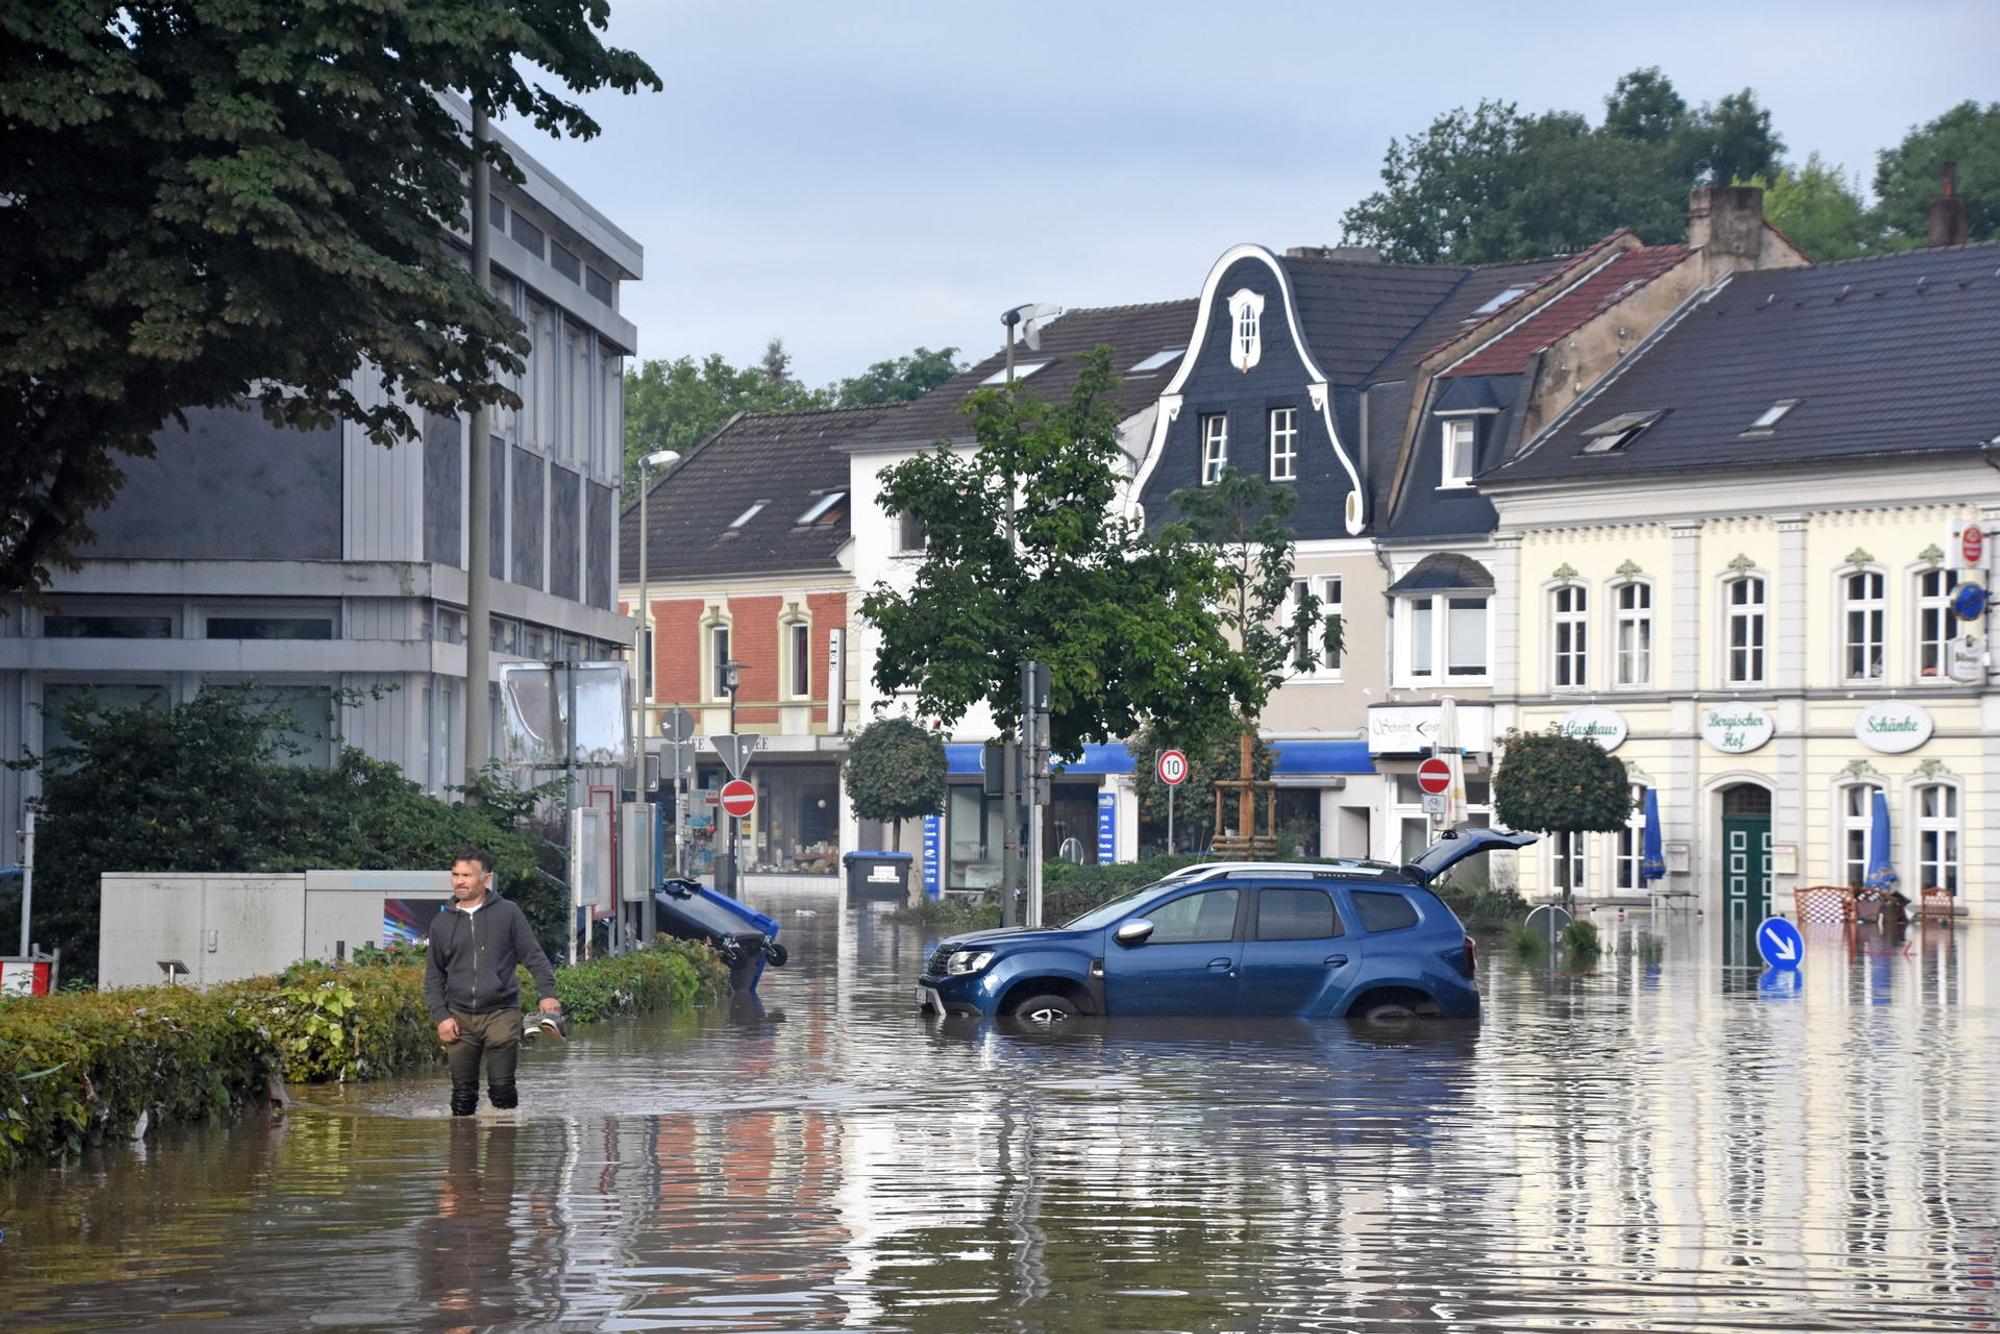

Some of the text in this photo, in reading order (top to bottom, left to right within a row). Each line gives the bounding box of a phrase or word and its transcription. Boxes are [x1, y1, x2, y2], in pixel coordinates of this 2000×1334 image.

[830, 635, 838, 671] TEE
[1708, 712, 1764, 730] Bergischer
[1866, 716, 1919, 733] Schänke
[1722, 732, 1746, 750] Hof
[1166, 759, 1180, 776] 10
